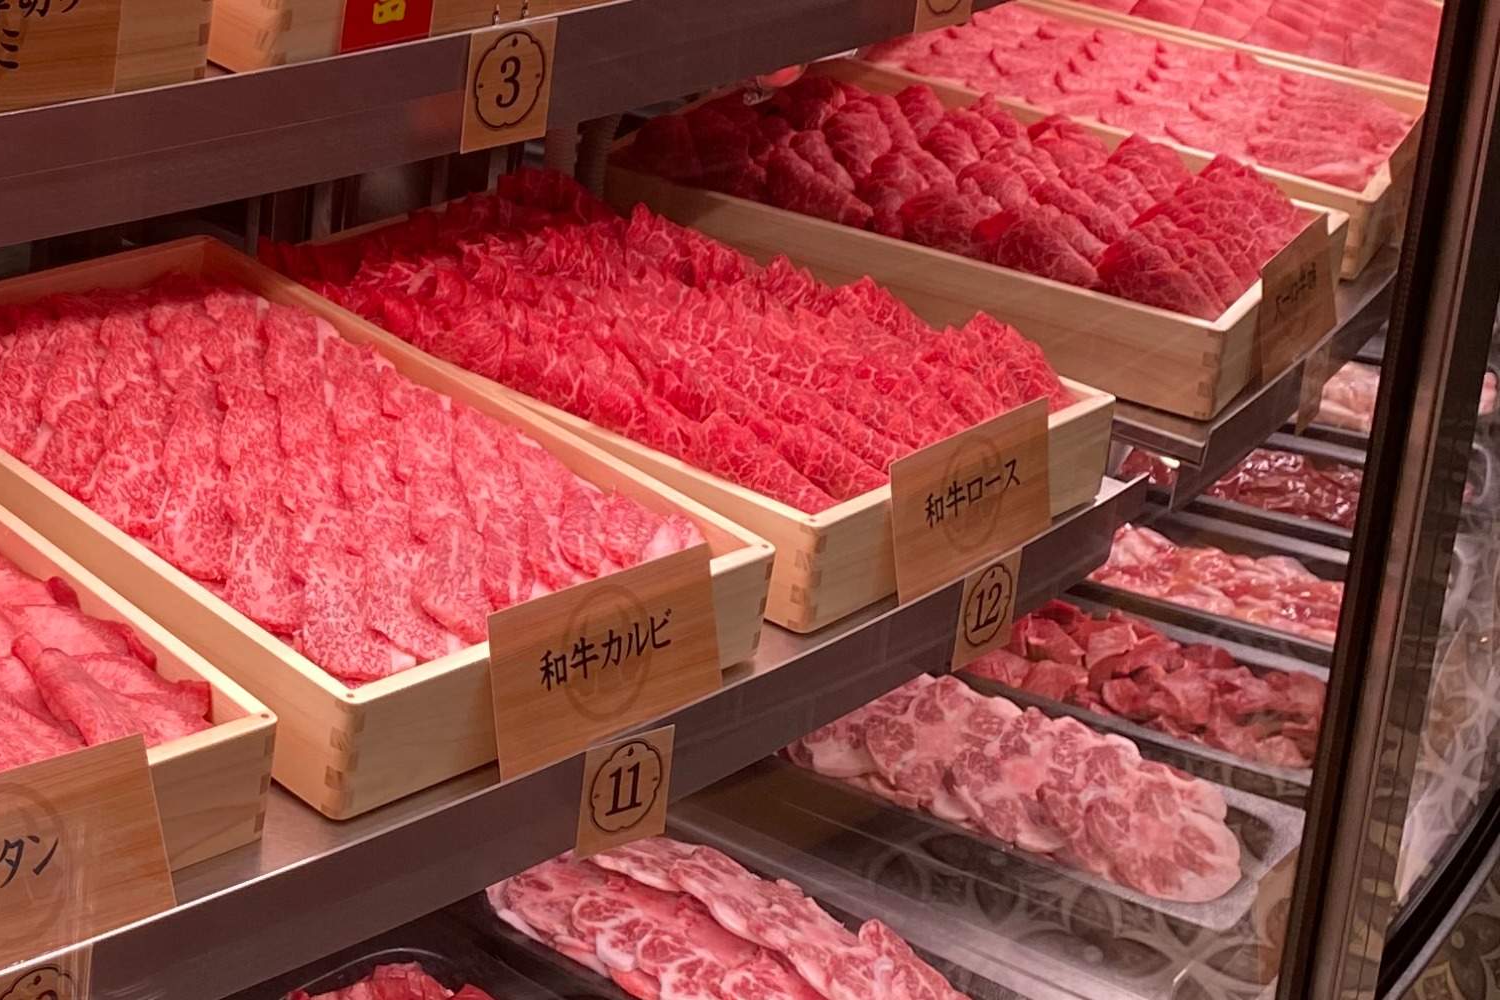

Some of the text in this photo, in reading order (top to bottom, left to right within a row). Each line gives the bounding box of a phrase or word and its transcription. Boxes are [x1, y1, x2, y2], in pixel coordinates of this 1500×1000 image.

[496, 57, 521, 108] 3
[924, 458, 1021, 529] 和牛ロース
[970, 582, 1004, 634] 12
[539, 607, 673, 692] 和牛カルビ
[604, 760, 643, 817] 11
